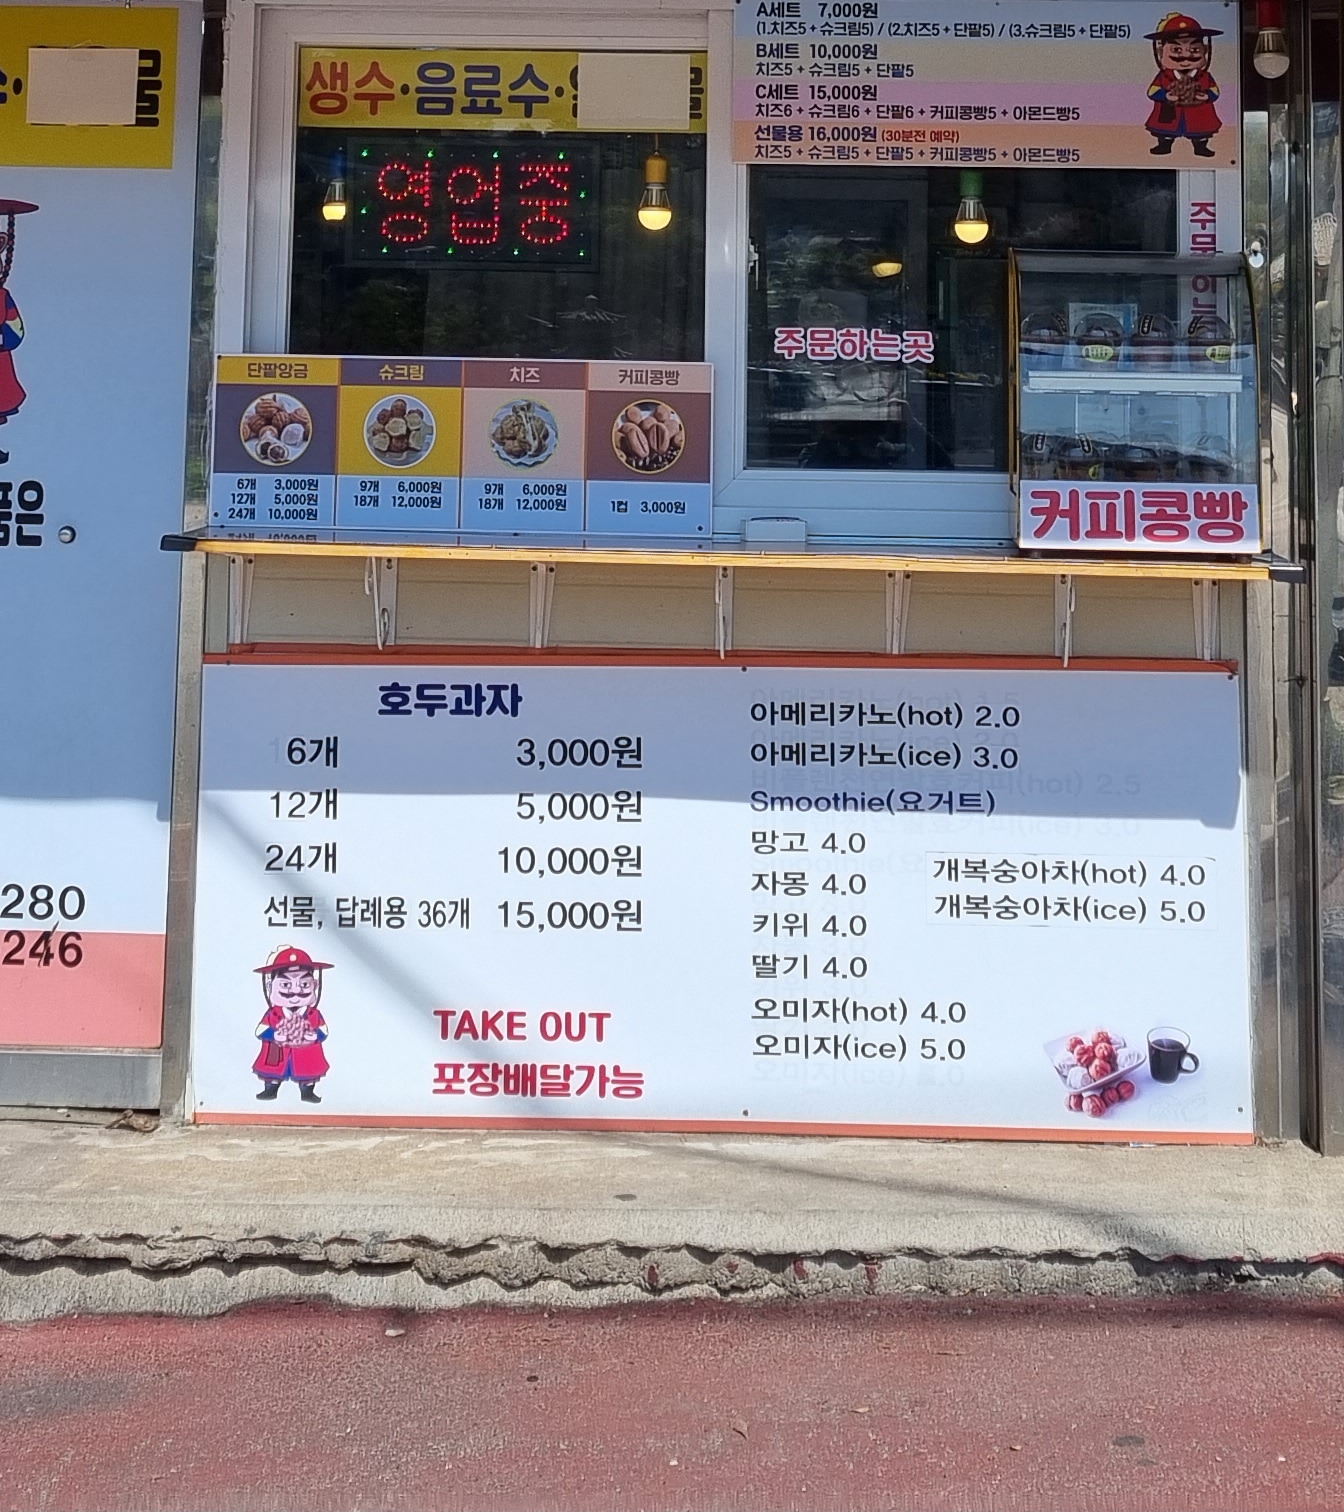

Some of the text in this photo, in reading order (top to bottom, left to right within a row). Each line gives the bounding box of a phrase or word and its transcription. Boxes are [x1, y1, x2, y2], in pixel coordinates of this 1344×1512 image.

[756, 2, 878, 19] A세트 7,000원
[756, 43, 878, 60] B세트 10,000원
[756, 62, 793, 77] 치즈5
[808, 62, 860, 77] 슈크림5
[755, 84, 878, 101] C세트 15,000원
[755, 104, 793, 118] 치즈6
[929, 105, 996, 121] 커피콩빵5
[1013, 106, 1080, 121] 아몬드빵5
[754, 125, 803, 142] 선물용
[808, 126, 877, 142] 16,000원
[754, 144, 792, 159] 치즈5
[807, 145, 859, 160] 슈크림5
[929, 147, 996, 162] 커피콩빵5
[1013, 147, 1080, 162] 아몬드빵5
[377, 161, 572, 245] 영업중
[774, 326, 935, 364] 주문하는곳
[378, 364, 424, 380] 슈크림
[509, 367, 541, 383] 치즈
[618, 368, 680, 385] 커피콩빵
[237, 479, 319, 491] 6개 3,000원
[360, 480, 442, 494] 9개 6,000원
[484, 483, 567, 496] 9개 6,000원
[231, 493, 318, 506] 12개 5,000원
[353, 495, 441, 509] 18개 12,000원
[478, 497, 567, 511] 18개 12,000원
[640, 501, 686, 514] 3,000원
[228, 508, 318, 520] 24개 10,000원
[1030, 488, 1249, 543] 커피콩빵
[377, 681, 523, 718] 호두과자
[750, 701, 1020, 729] 아메리카노(hot) 2.0
[286, 736, 643, 770] 6개 3,000원
[750, 742, 1019, 770] 아메리카노(ice) 3.0
[269, 788, 643, 823] 12개 5,000원
[750, 790, 996, 817] Smoothie(요거트)
[751, 830, 866, 855] 망고 4.0
[264, 842, 643, 878] 24개 10,000원
[751, 872, 867, 897] 자몽 4.0
[932, 859, 1206, 887] 개복숭아차(hot) 4.0
[263, 896, 643, 932] 선물, 답례용 36개 15,000원
[934, 894, 1206, 923] 개복숭아차(ice) 5.0
[752, 912, 867, 938] 키위 4.0
[752, 954, 867, 980] 딸기 4.0
[752, 997, 966, 1025] 오미자(hot) 4.0
[432, 1009, 611, 1043] TAKE OUT
[753, 1034, 966, 1062] 오미자(ice) 5.0
[432, 1062, 645, 1099] 포장배달가능
